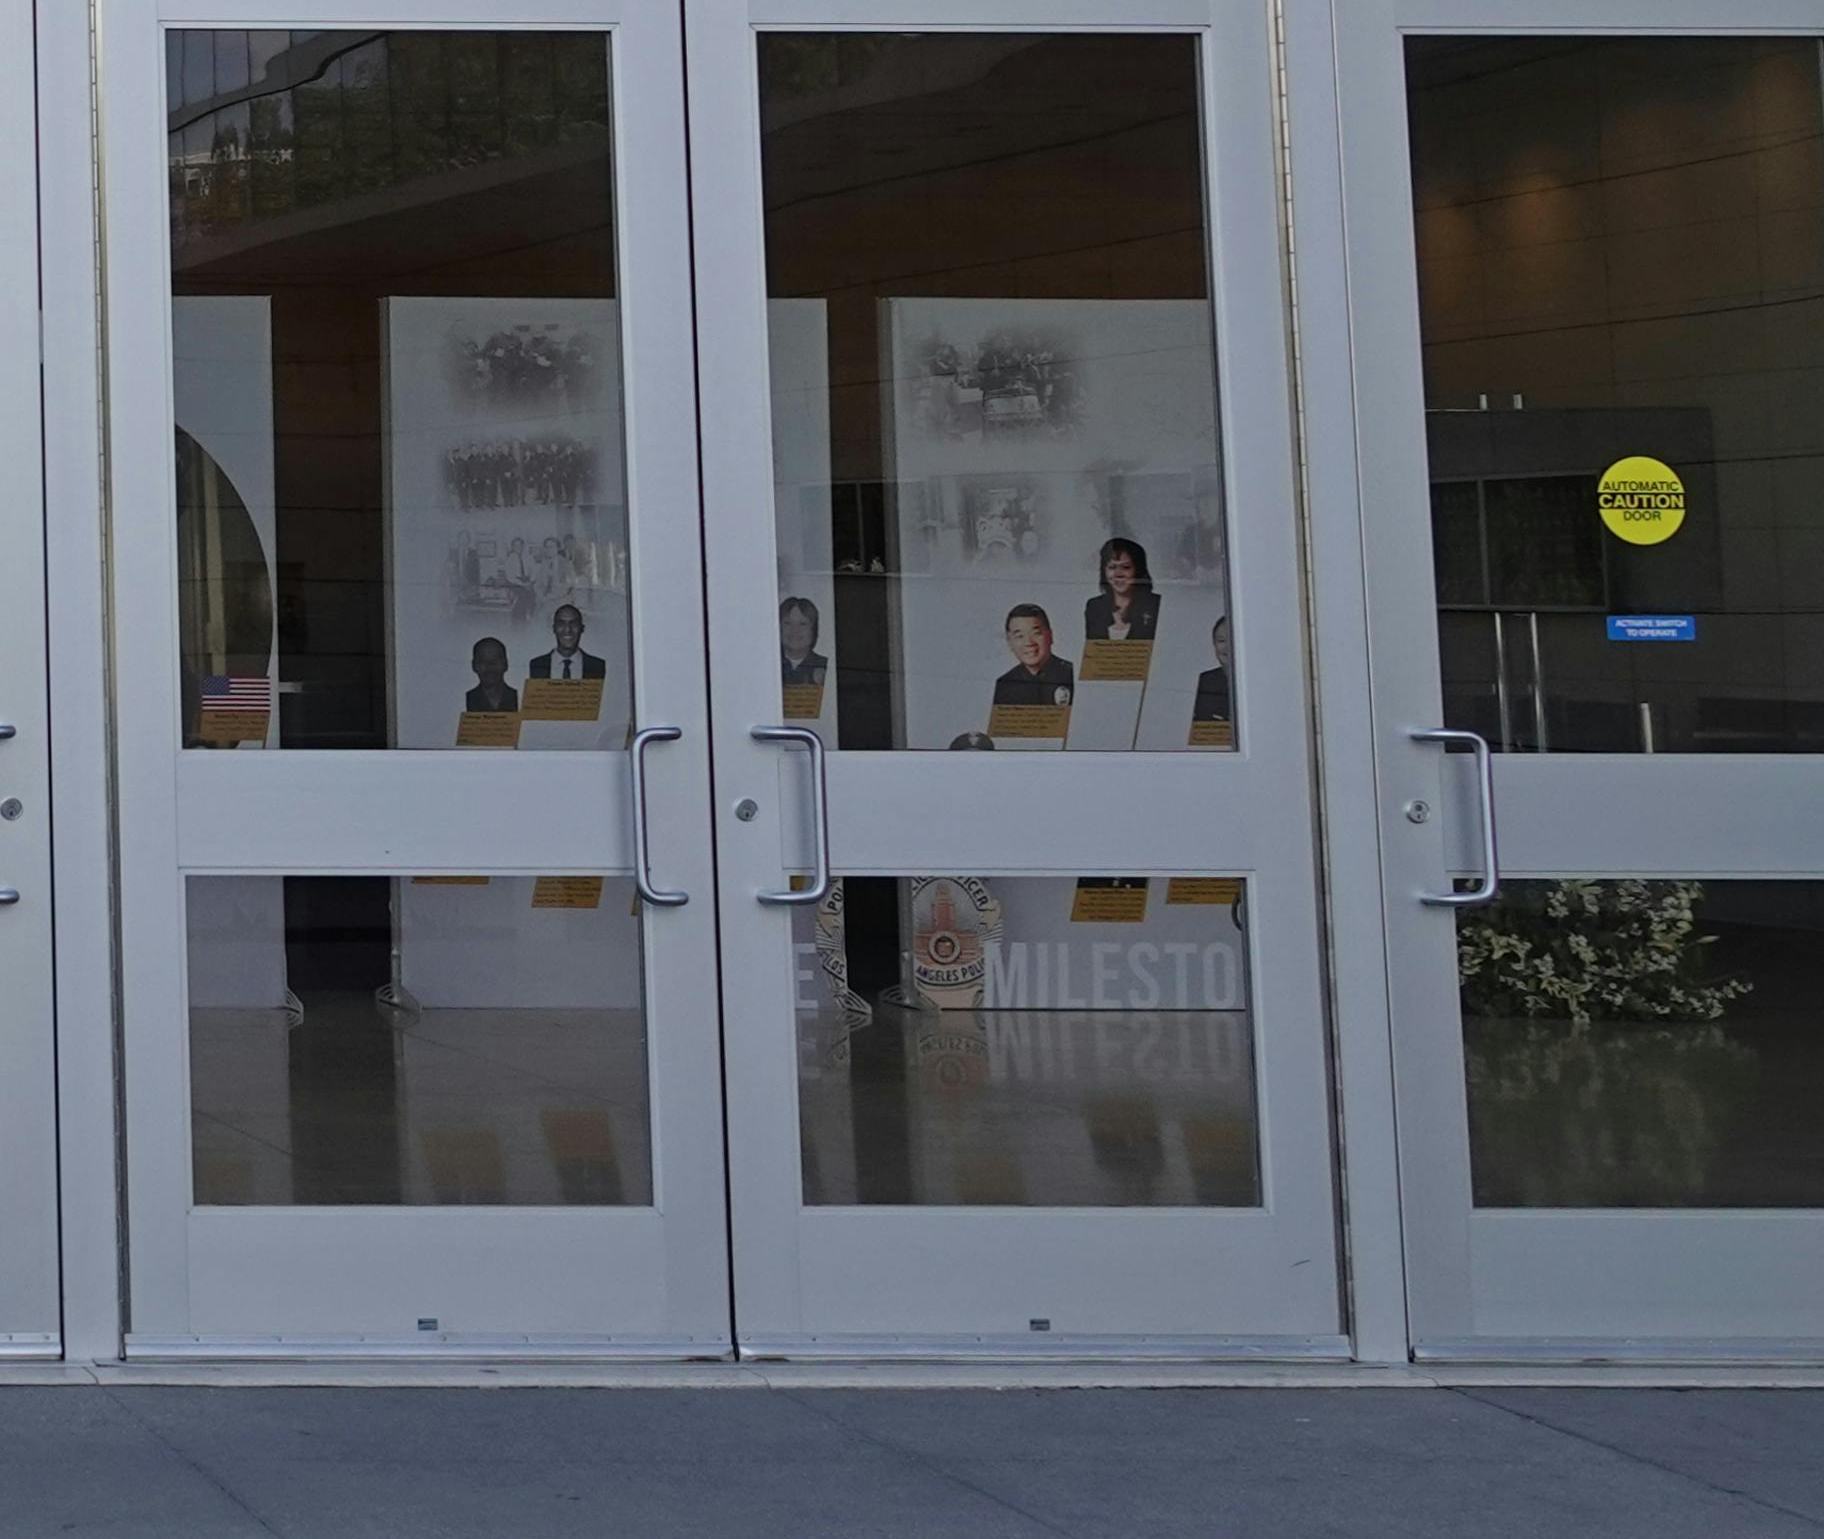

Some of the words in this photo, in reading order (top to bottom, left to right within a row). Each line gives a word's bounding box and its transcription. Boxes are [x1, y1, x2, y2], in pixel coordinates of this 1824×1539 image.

[1602, 481, 1680, 492] AUTOMATIC
[1599, 494, 1684, 508] CAUTION
[1623, 511, 1662, 522] DOOR
[982, 942, 1238, 1009] MILESTO
